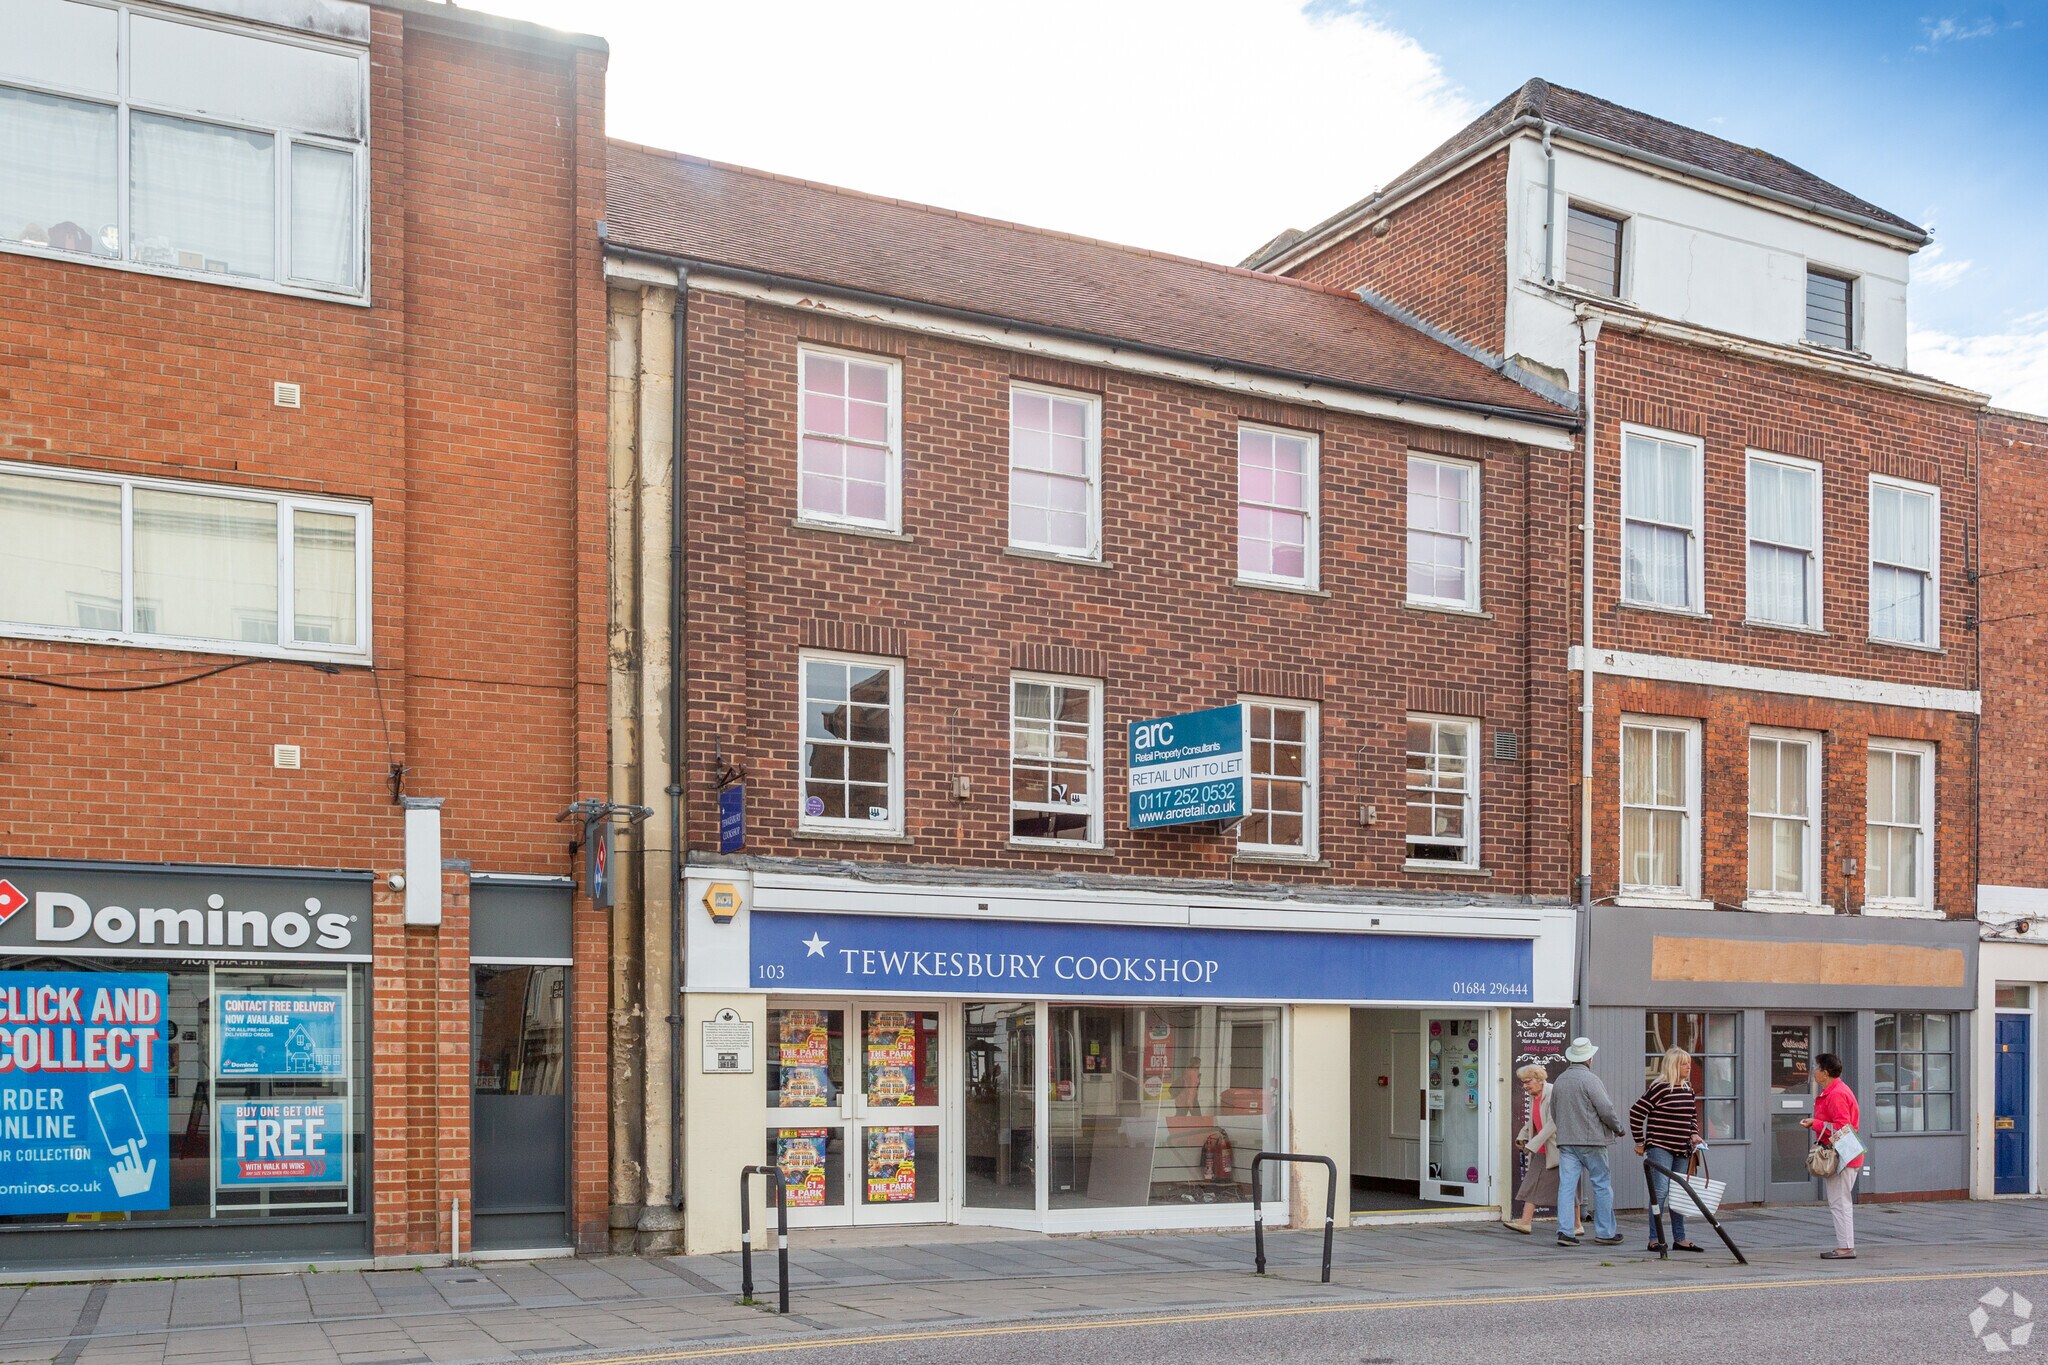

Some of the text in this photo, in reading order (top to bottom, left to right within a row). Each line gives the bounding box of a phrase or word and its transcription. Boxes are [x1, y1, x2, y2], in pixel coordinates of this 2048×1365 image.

[1135, 722, 1174, 749] arc
[1135, 742, 1220, 763] Retail Property Consultants
[1132, 758, 1242, 786] RETAIL UNIT TO LET
[1139, 782, 1235, 810] 0117 252 0532
[1138, 800, 1236, 823] www.arcretail.co.uk
[35, 891, 353, 949] Domino's
[758, 965, 785, 979] 103
[839, 949, 1220, 983] TEWKESBURY COOKSHOP
[1453, 981, 1528, 995] 01684 296444
[91, 987, 160, 1023] AND
[225, 1000, 336, 1013] CONTACT FREE DELIVERY
[225, 1014, 289, 1025] NOW AVAILABLE
[1523, 1030, 1538, 1038] Class
[1538, 1030, 1546, 1039] of
[1546, 1031, 1566, 1040] Beauty
[0, 1088, 64, 1111] RDER
[236, 1105, 325, 1118] BUY ONE GET ONE
[0, 1115, 77, 1139] NLINE
[236, 1118, 326, 1158] FREE
[16, 1148, 91, 1162] COLLECTION
[245, 1162, 305, 1171] WITH WALK IN WINS
[0, 1180, 102, 1195] ominos.co.uk
[870, 1183, 887, 1191] THE
[889, 1182, 912, 1190] PARK
